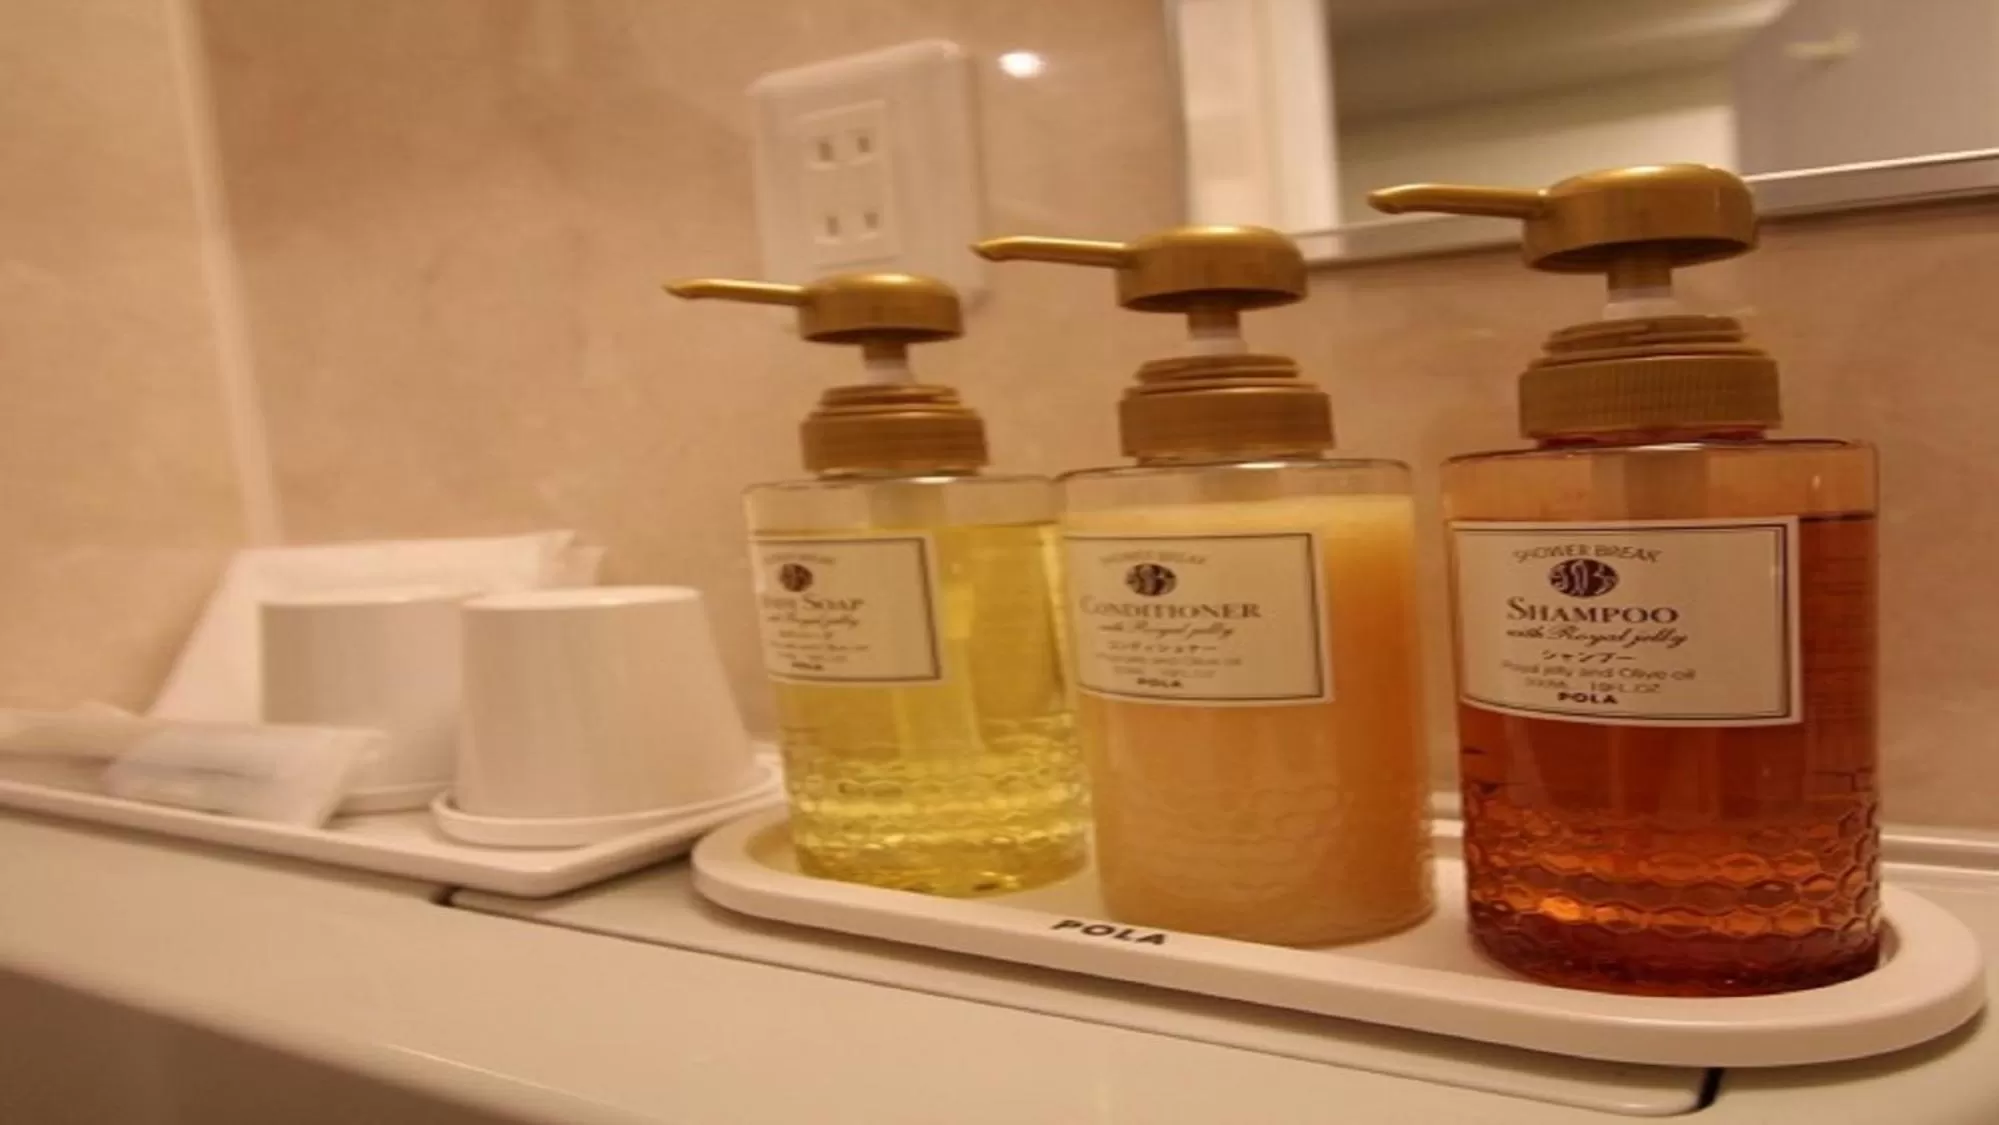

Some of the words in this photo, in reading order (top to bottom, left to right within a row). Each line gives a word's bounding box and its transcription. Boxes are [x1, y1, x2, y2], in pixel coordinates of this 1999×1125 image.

[1594, 544, 1663, 563] BREAK
[1547, 625, 1632, 648] Royal
[1557, 691, 1619, 705] POLA
[1051, 909, 1165, 945] POLA
